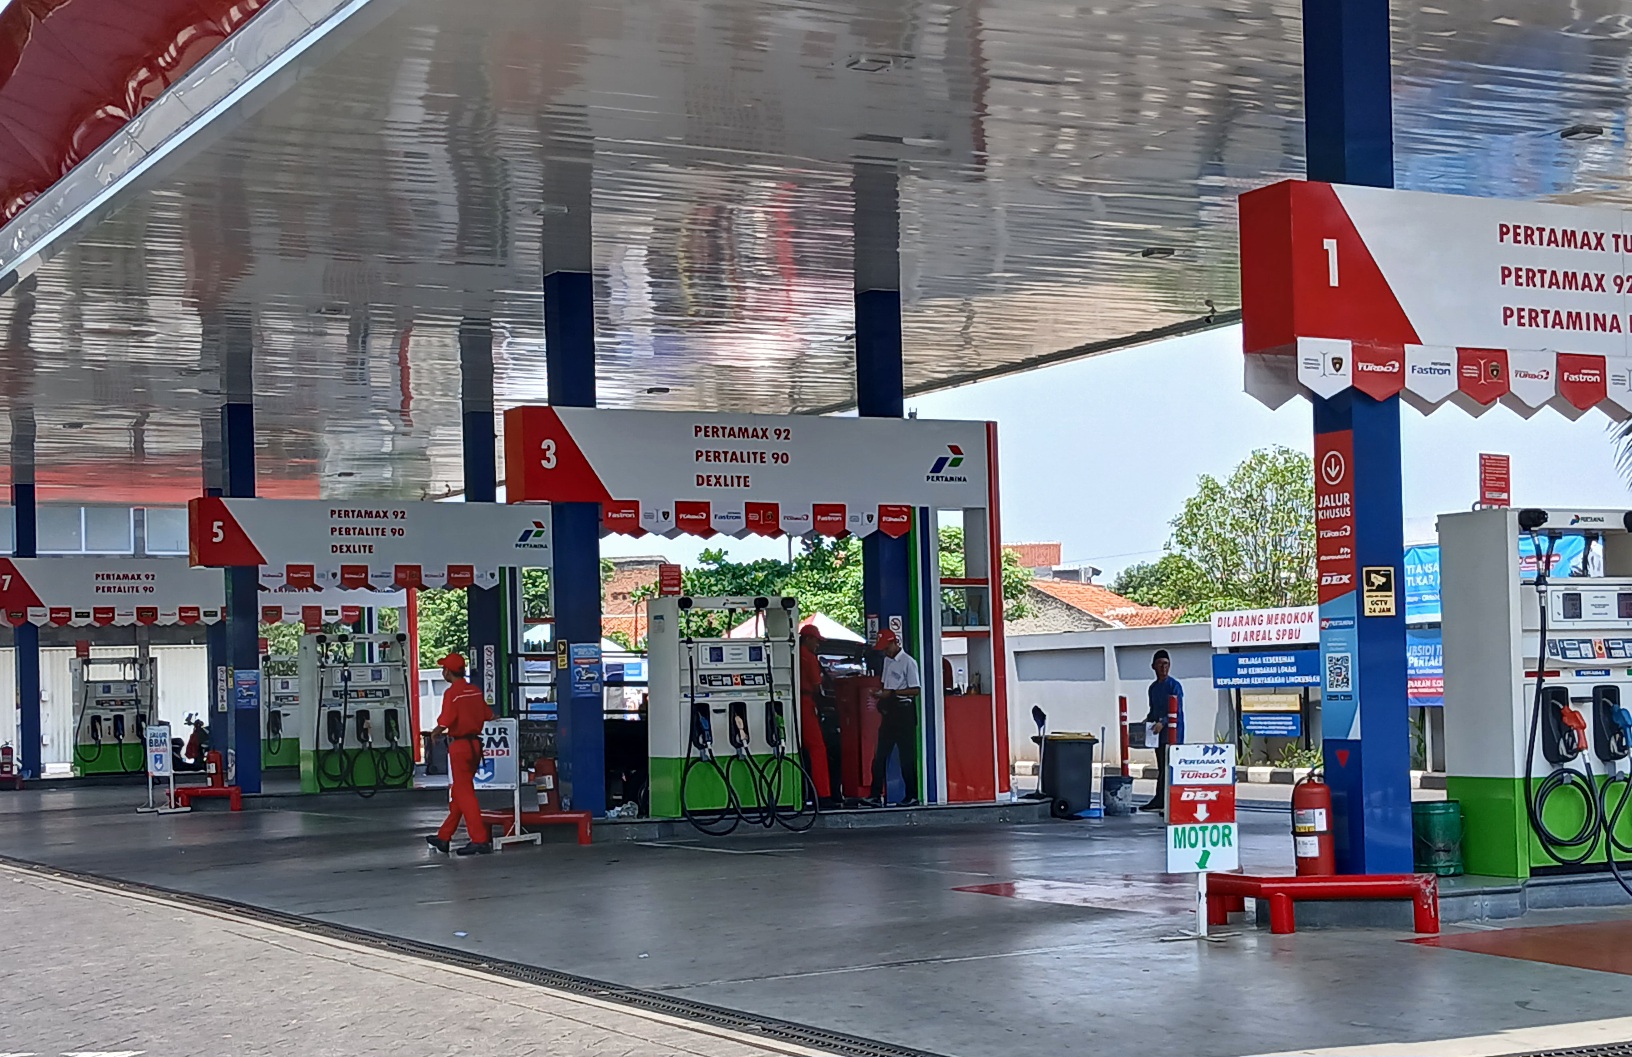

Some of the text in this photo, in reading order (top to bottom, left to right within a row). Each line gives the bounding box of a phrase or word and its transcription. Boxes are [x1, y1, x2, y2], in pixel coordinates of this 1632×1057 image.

[1499, 223, 1632, 253] PERTAMAX TU
[1323, 239, 1339, 287] 1
[1501, 266, 1607, 293] PERTAMAX
[1503, 306, 1622, 333] PERTAMINA
[1411, 364, 1451, 376] Fastron
[1563, 371, 1601, 382] Fastron
[695, 425, 790, 440] PERTAMAX 92
[541, 439, 557, 469] 3
[696, 450, 789, 464] PERTALITE 90
[696, 474, 750, 487] DEXLITE
[1318, 493, 1350, 508] JALUR
[331, 509, 406, 519] PERTAMAX 92
[608, 511, 635, 519] Fastron
[1318, 507, 1350, 519] KHUSUS
[212, 521, 224, 542] 5
[331, 527, 404, 536] PERTALITE 90
[331, 545, 374, 553] DEXLITE
[1, 575, 12, 590] 7
[95, 573, 155, 581] PERTAMAX 92
[1321, 575, 1351, 585] DEX
[1217, 611, 1314, 628] DILARANG MEROKOK
[1231, 627, 1301, 642] DI AREAL SPBU
[1180, 791, 1219, 801] DEX
[1174, 825, 1232, 848] MOTOR
